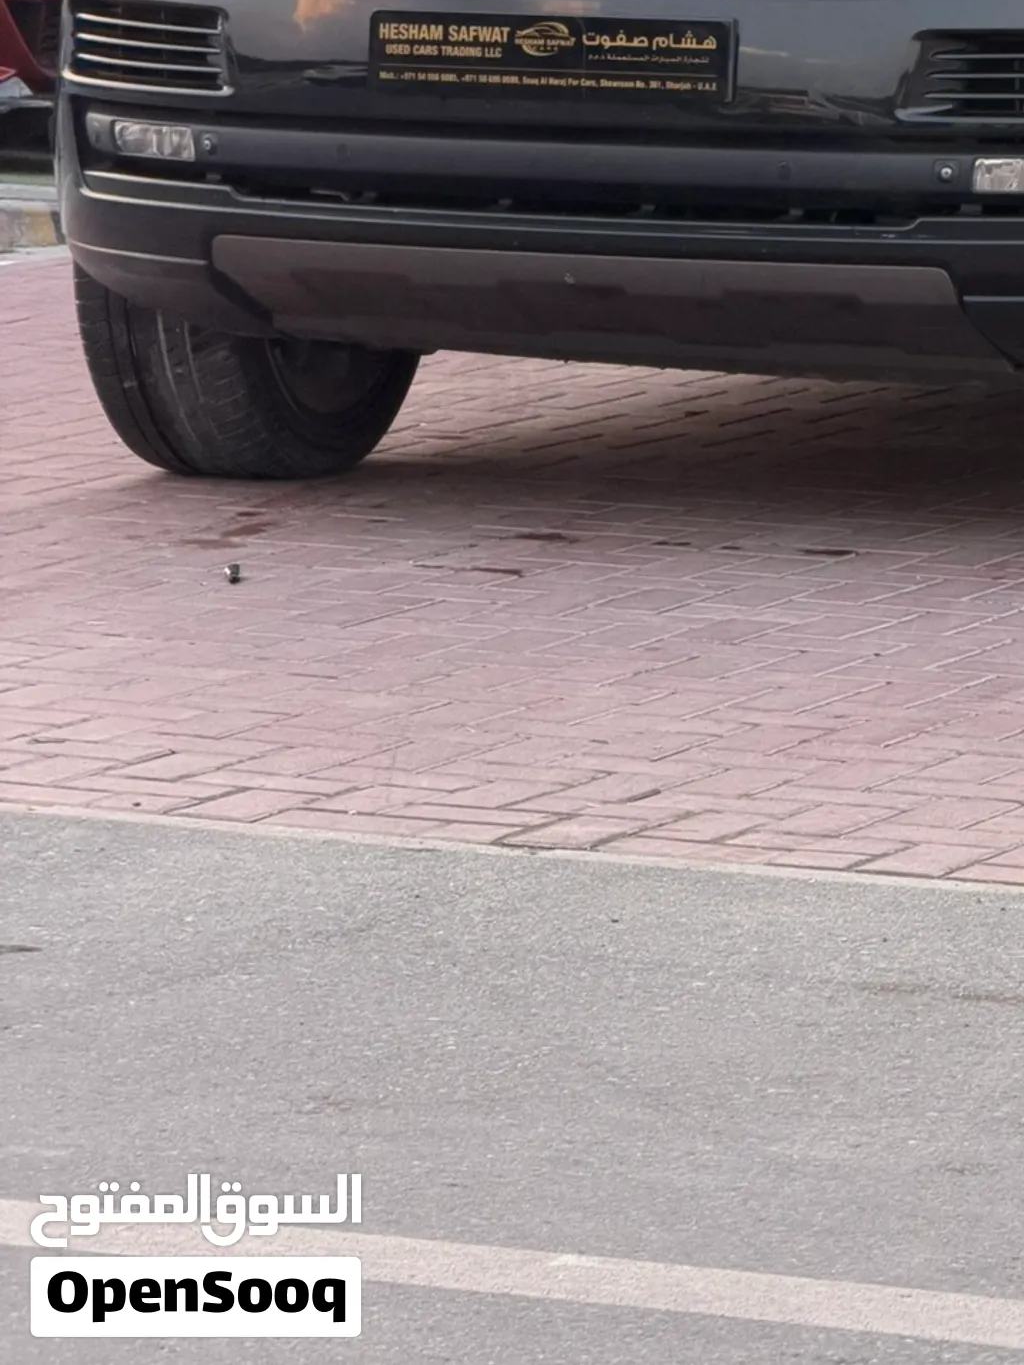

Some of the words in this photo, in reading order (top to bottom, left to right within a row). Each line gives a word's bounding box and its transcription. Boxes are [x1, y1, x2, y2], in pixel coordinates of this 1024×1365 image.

[379, 22, 444, 41] HESHAM
[448, 24, 511, 44] SAFWAT
[581, 29, 649, 50] صفوت
[652, 29, 718, 50] هشام
[385, 43, 411, 55] USED
[412, 44, 438, 56] CARS
[440, 45, 482, 58] TRADING
[484, 46, 503, 58] LLC
